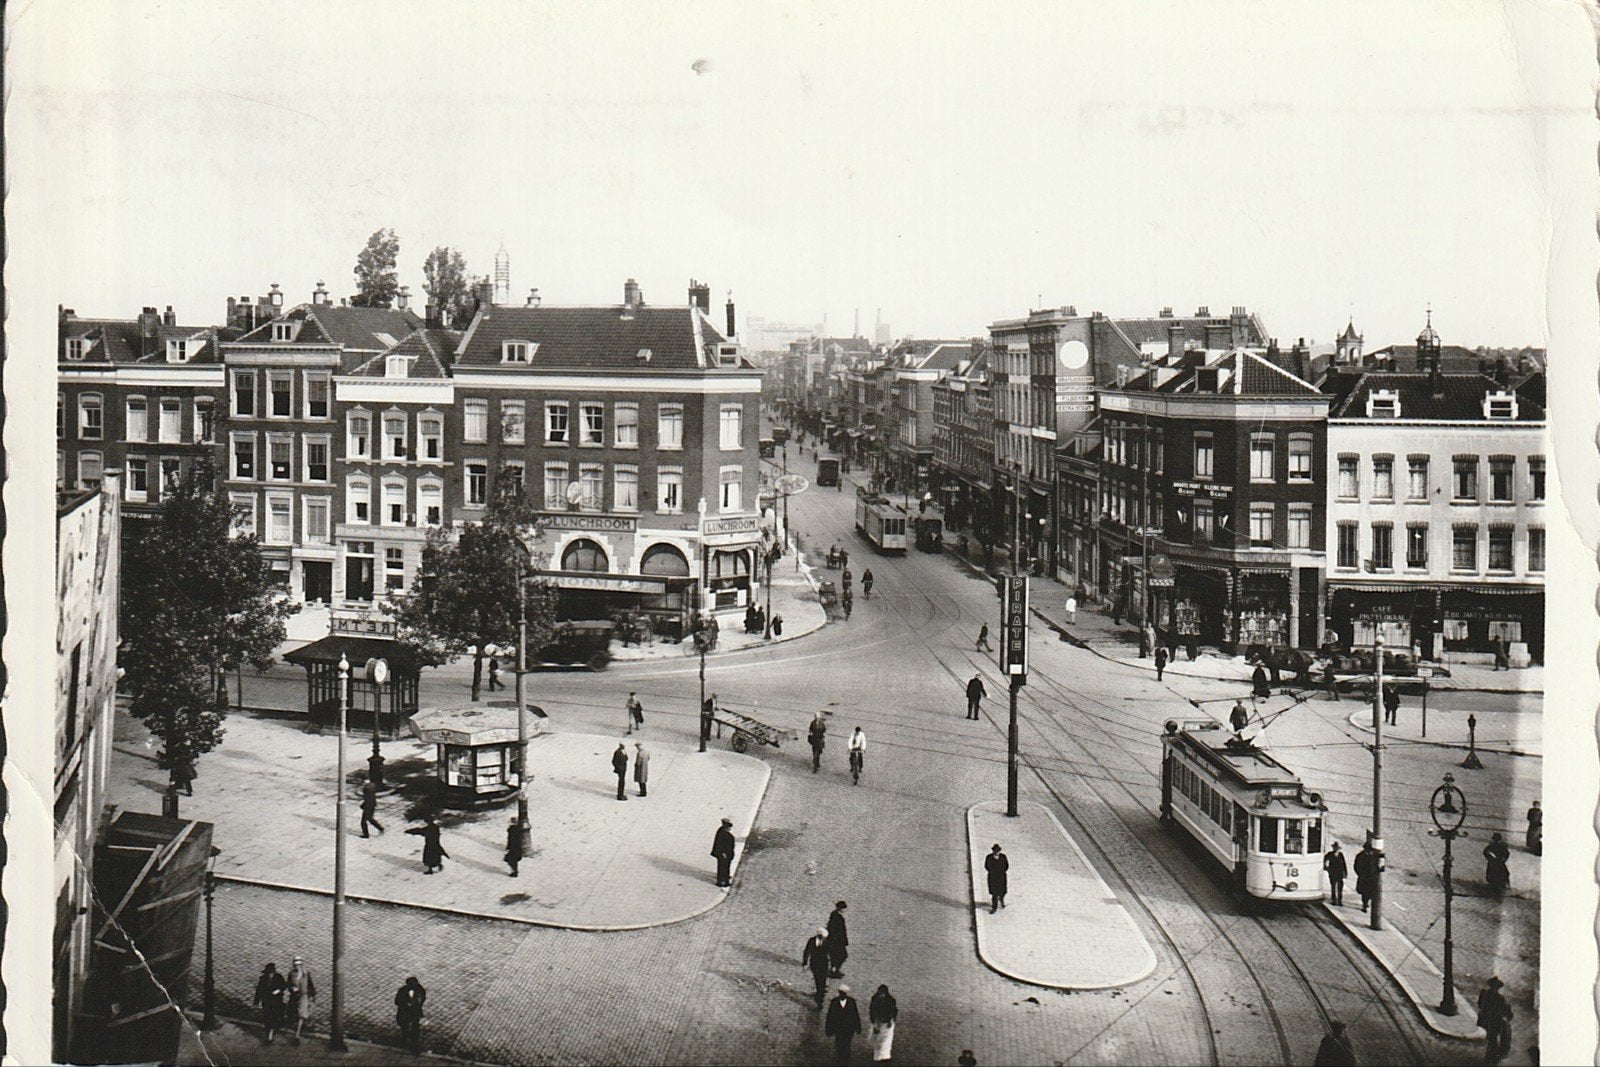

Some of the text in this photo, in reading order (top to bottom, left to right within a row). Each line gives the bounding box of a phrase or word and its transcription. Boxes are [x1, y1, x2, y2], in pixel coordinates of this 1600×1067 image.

[553, 516, 631, 529] LUNCHROOM
[707, 519, 756, 532] LUNCHROOM
[1011, 578, 1023, 651] PIRATE
[1286, 867, 1299, 877] 18
